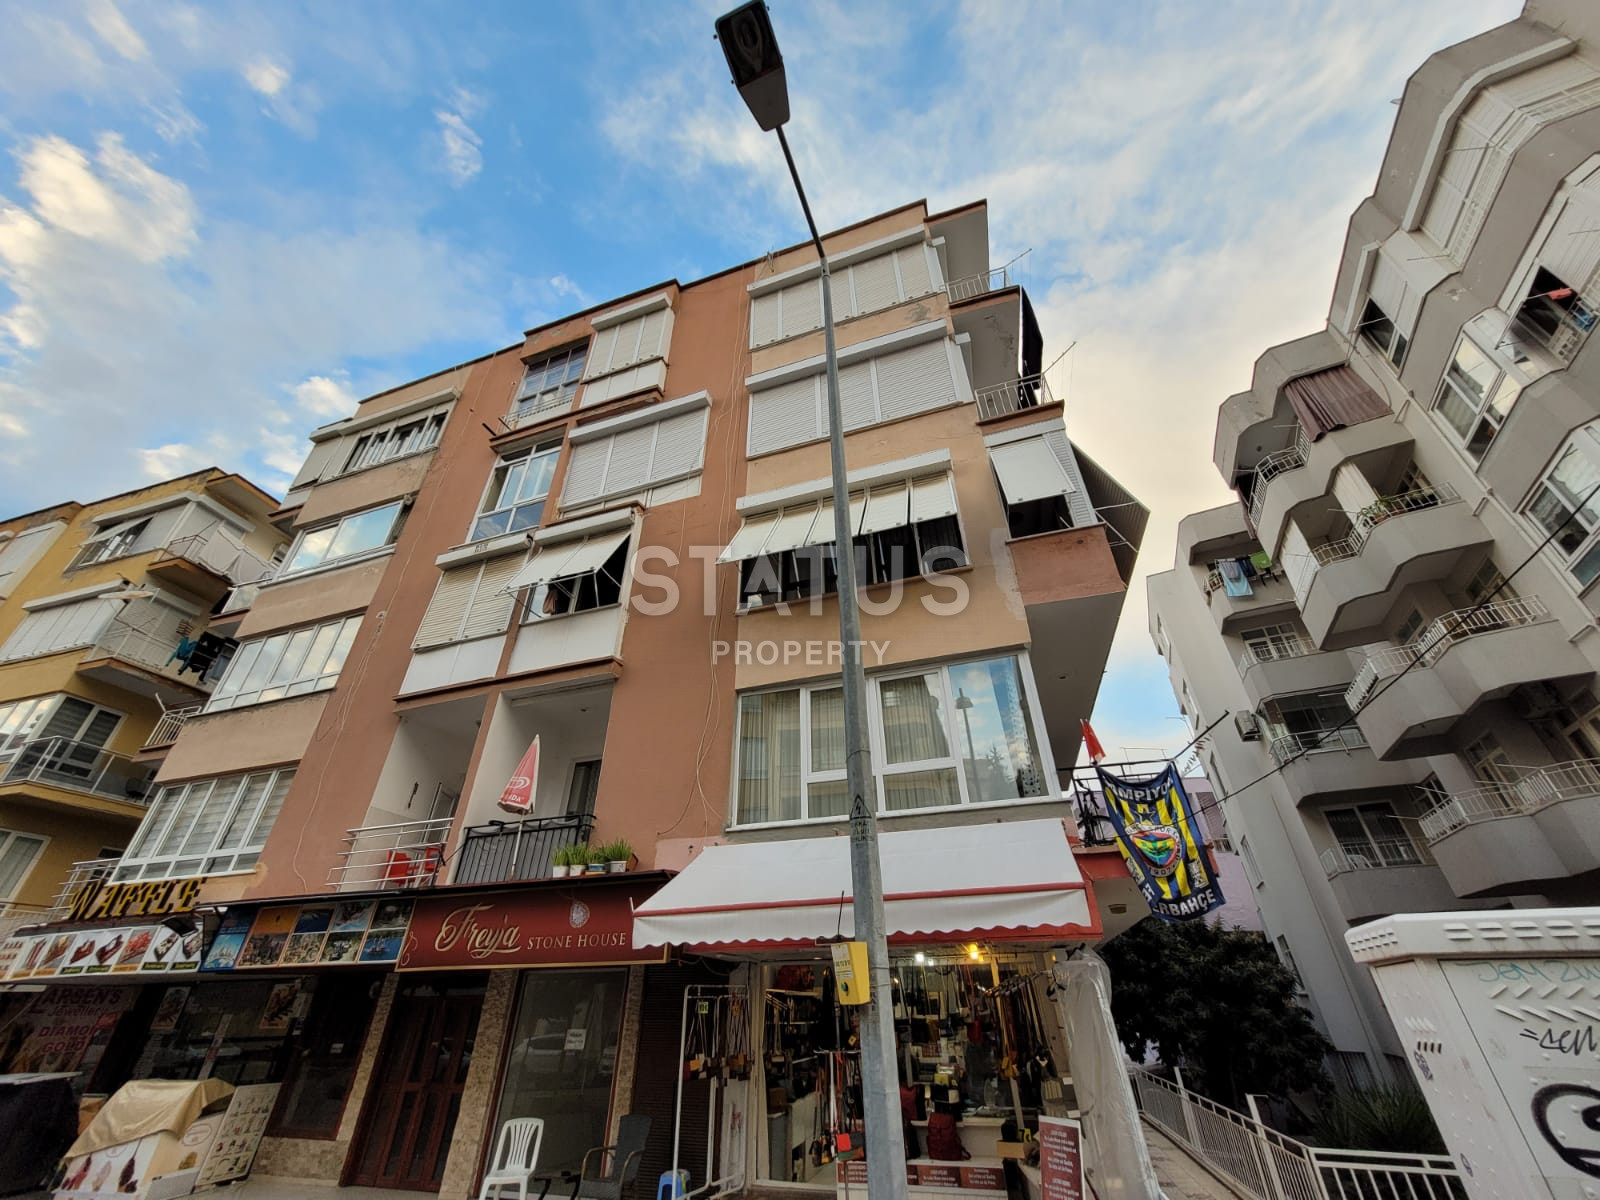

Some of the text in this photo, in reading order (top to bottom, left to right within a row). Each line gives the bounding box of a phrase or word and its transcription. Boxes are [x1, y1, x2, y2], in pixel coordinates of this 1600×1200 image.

[69, 877, 206, 920] WAFFLE
[434, 902, 627, 959] Freyja STONE HOUSE
